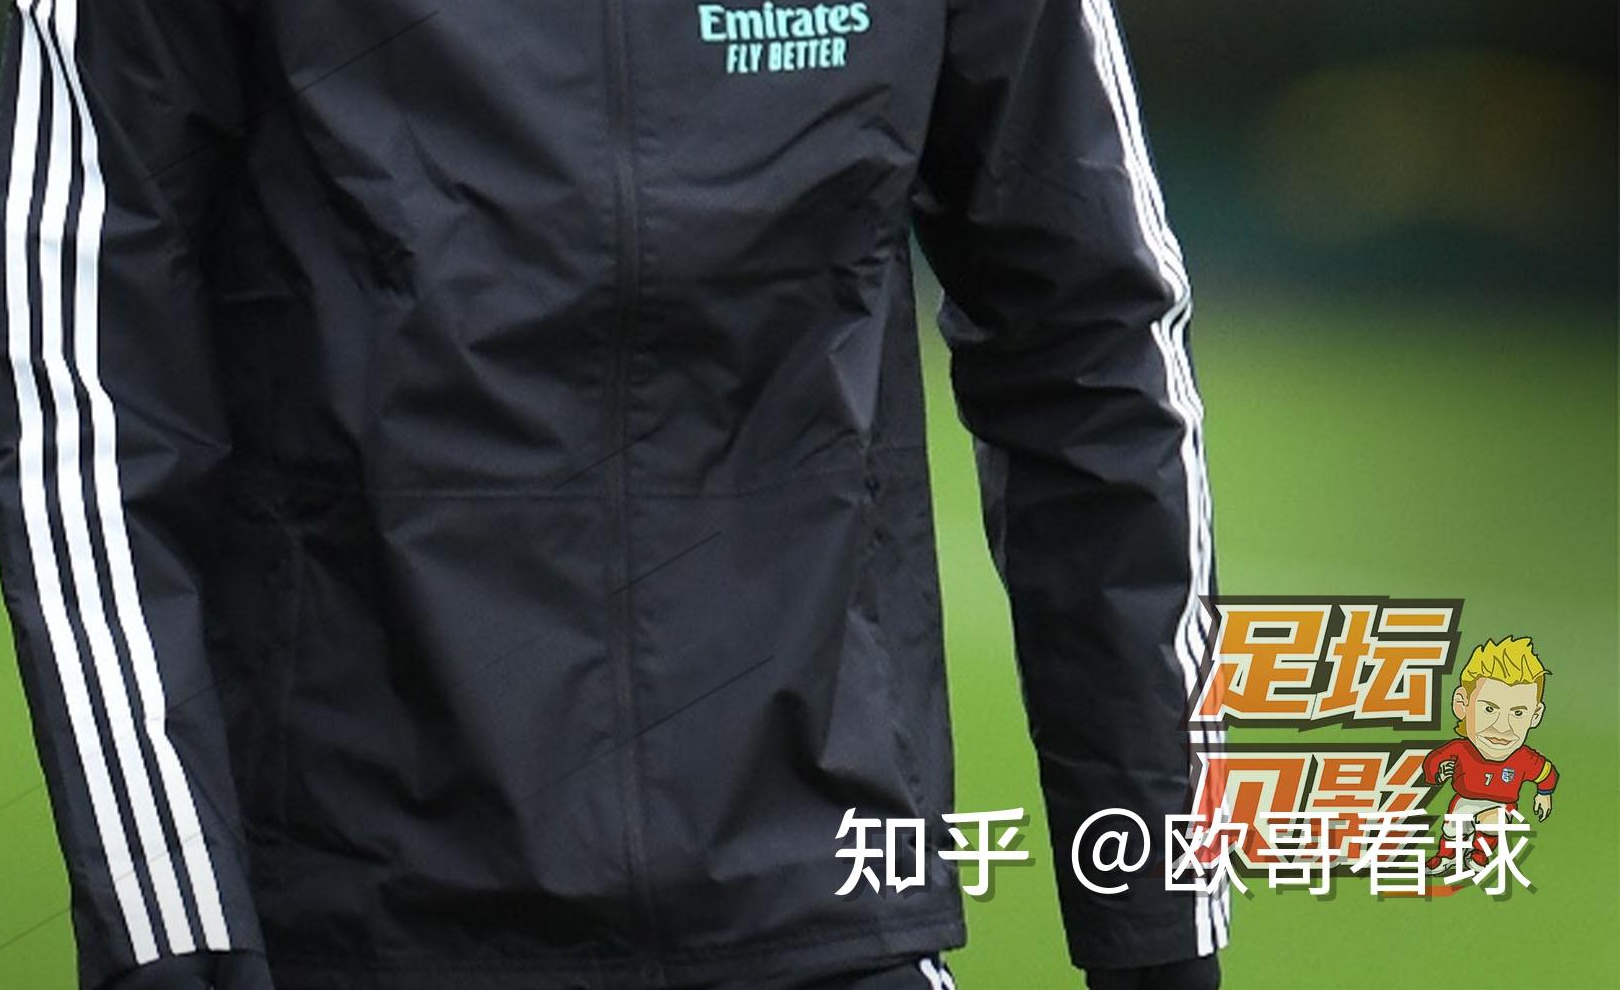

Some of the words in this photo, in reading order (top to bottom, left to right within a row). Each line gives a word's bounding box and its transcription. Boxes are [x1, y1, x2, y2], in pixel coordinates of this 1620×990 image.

[698, 0, 870, 42] Emirates
[726, 43, 765, 74] FLY
[768, 37, 848, 71] BETTER
